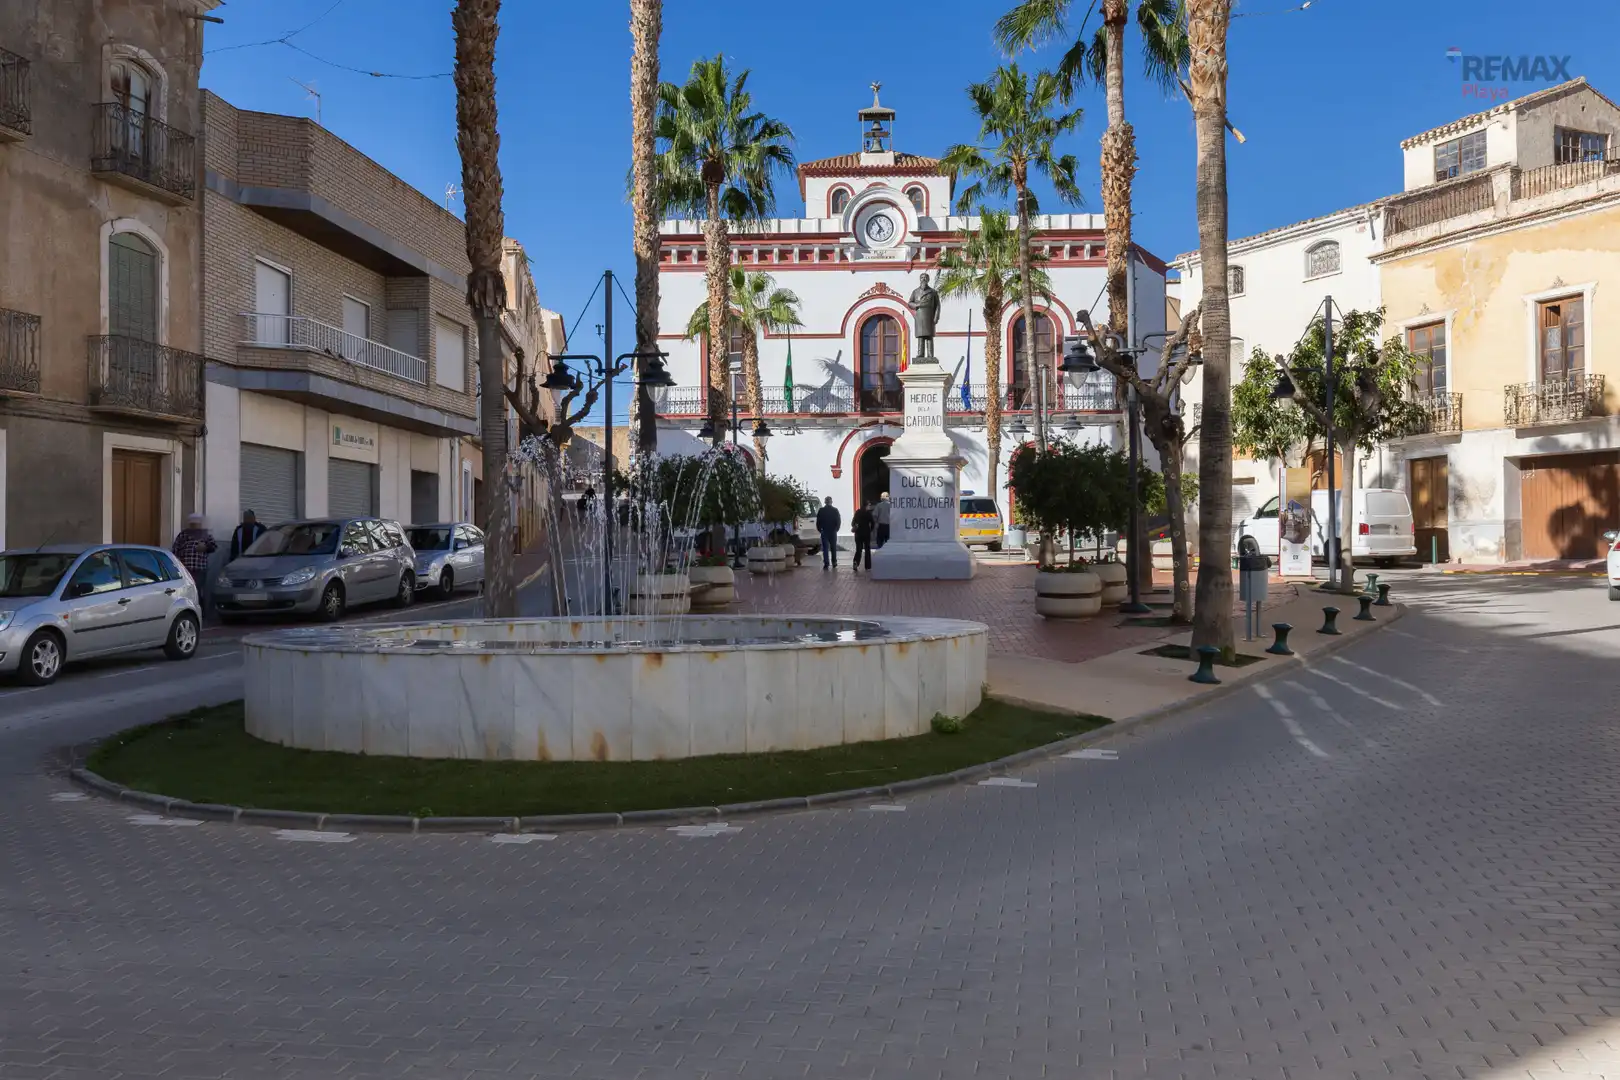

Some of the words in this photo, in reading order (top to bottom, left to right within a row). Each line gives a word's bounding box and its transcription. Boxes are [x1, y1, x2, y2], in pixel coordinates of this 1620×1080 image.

[910, 393, 938, 403] HEROE
[906, 415, 942, 427] CARIDAD
[901, 475, 944, 488] CUEVAS
[904, 517, 940, 530] LORCA
